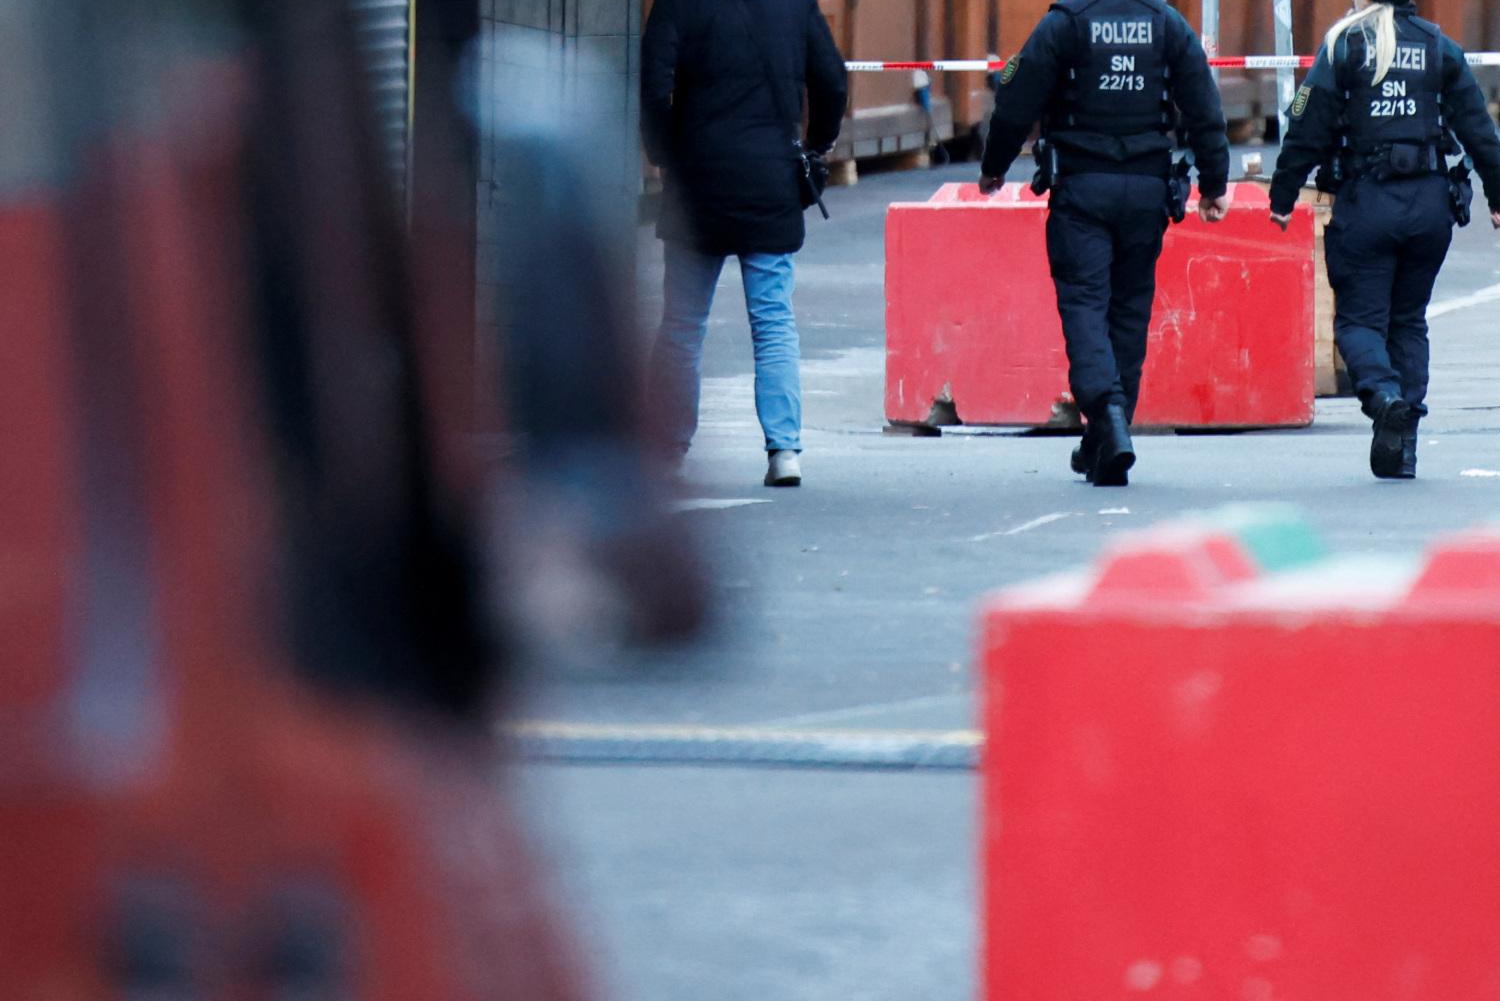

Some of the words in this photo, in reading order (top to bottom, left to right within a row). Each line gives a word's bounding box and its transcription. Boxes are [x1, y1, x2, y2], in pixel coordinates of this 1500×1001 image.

[1091, 22, 1153, 44] POLIZEI
[1111, 55, 1135, 72] SN
[1366, 45, 1426, 71] PIZEI
[1099, 75, 1145, 91] 22/13
[1382, 80, 1406, 97] SN
[1370, 98, 1416, 117] 22/13
